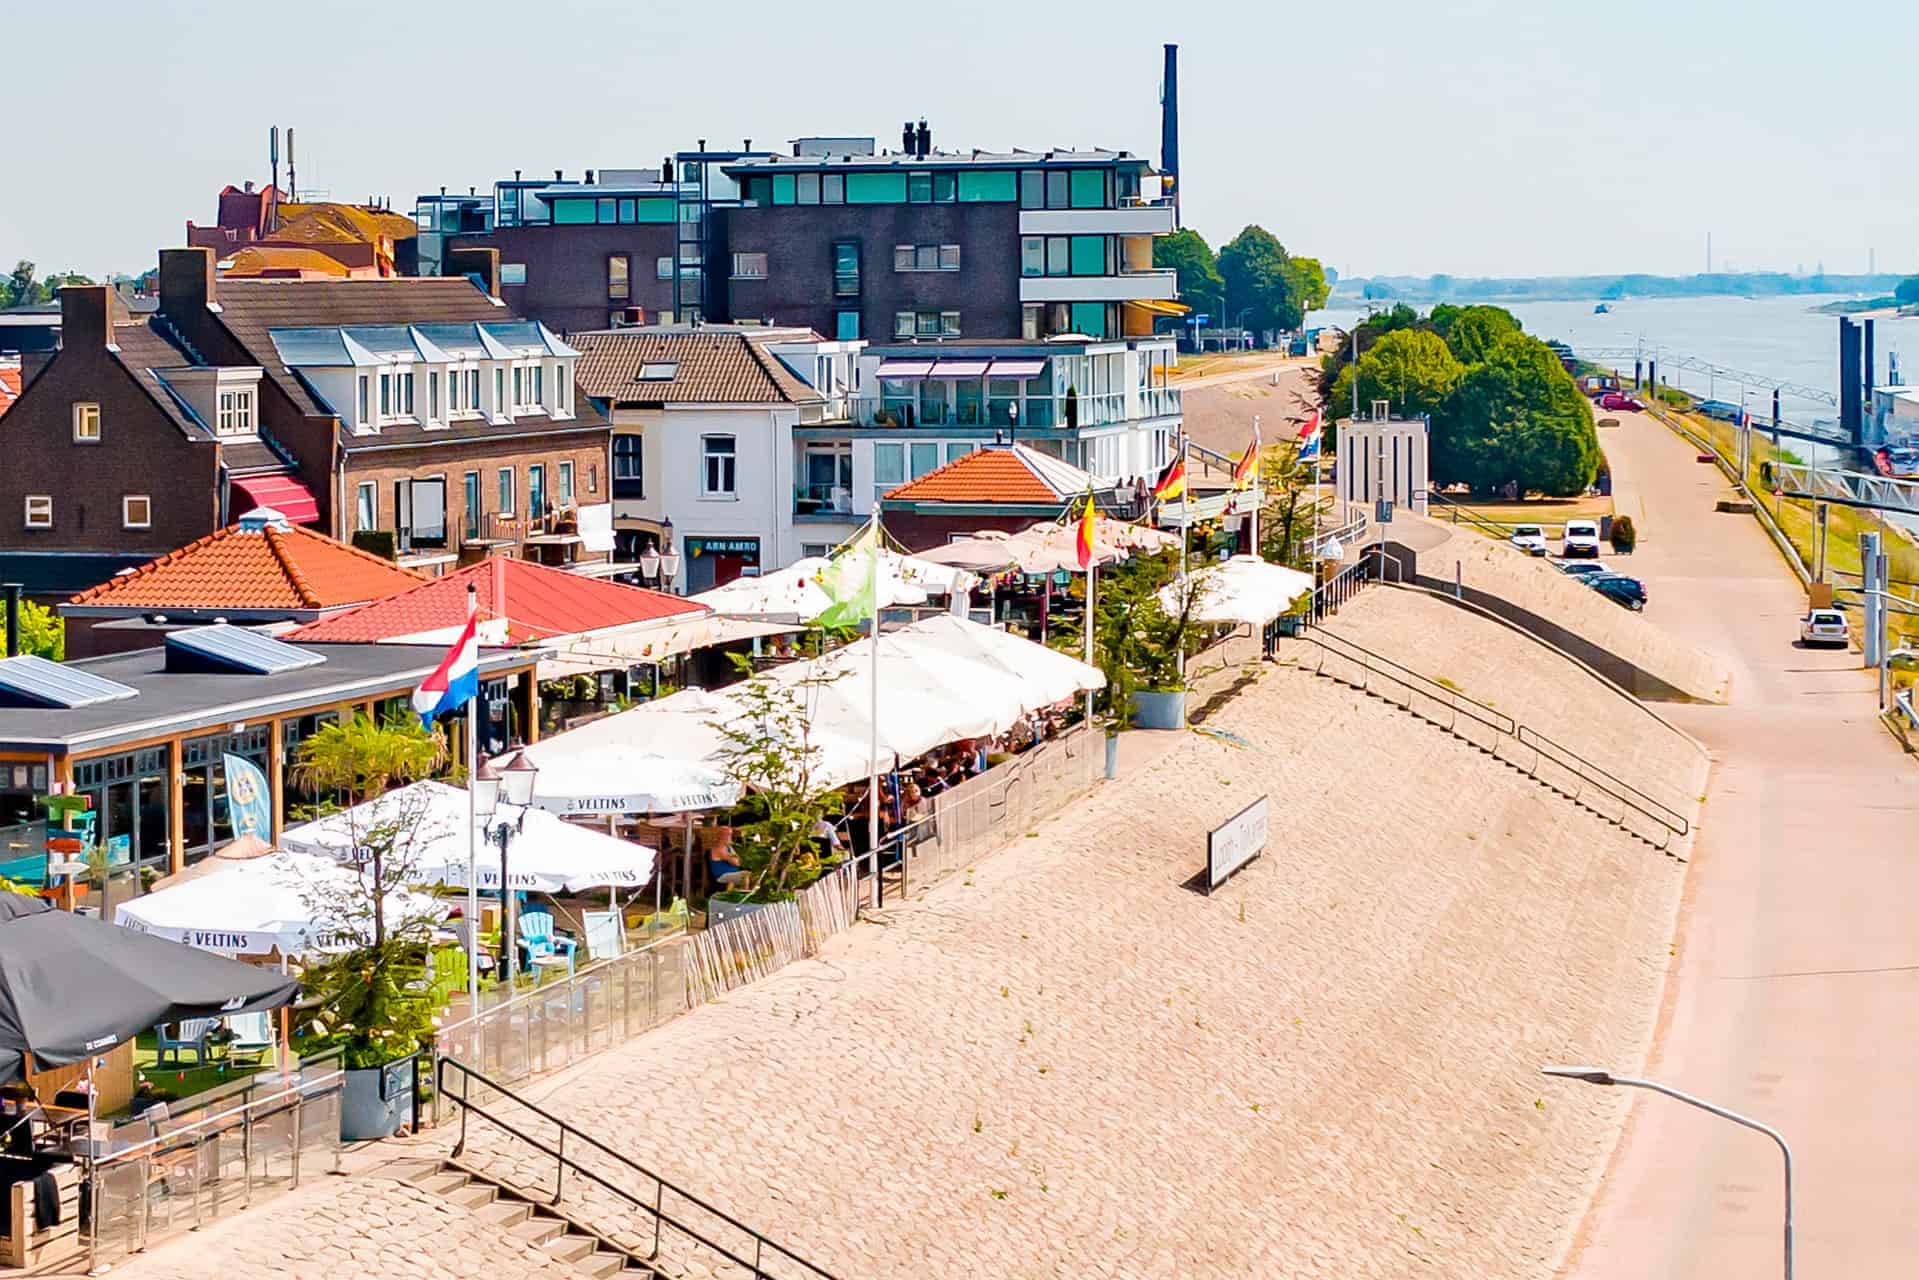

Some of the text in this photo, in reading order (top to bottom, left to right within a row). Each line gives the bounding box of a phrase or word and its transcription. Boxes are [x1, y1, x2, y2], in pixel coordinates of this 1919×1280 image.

[578, 798, 626, 809] VELTINS
[681, 794, 717, 806] VELTINS
[484, 873, 537, 885] VETINS
[599, 870, 637, 882] VETINS
[196, 932, 248, 948] VELTINS
